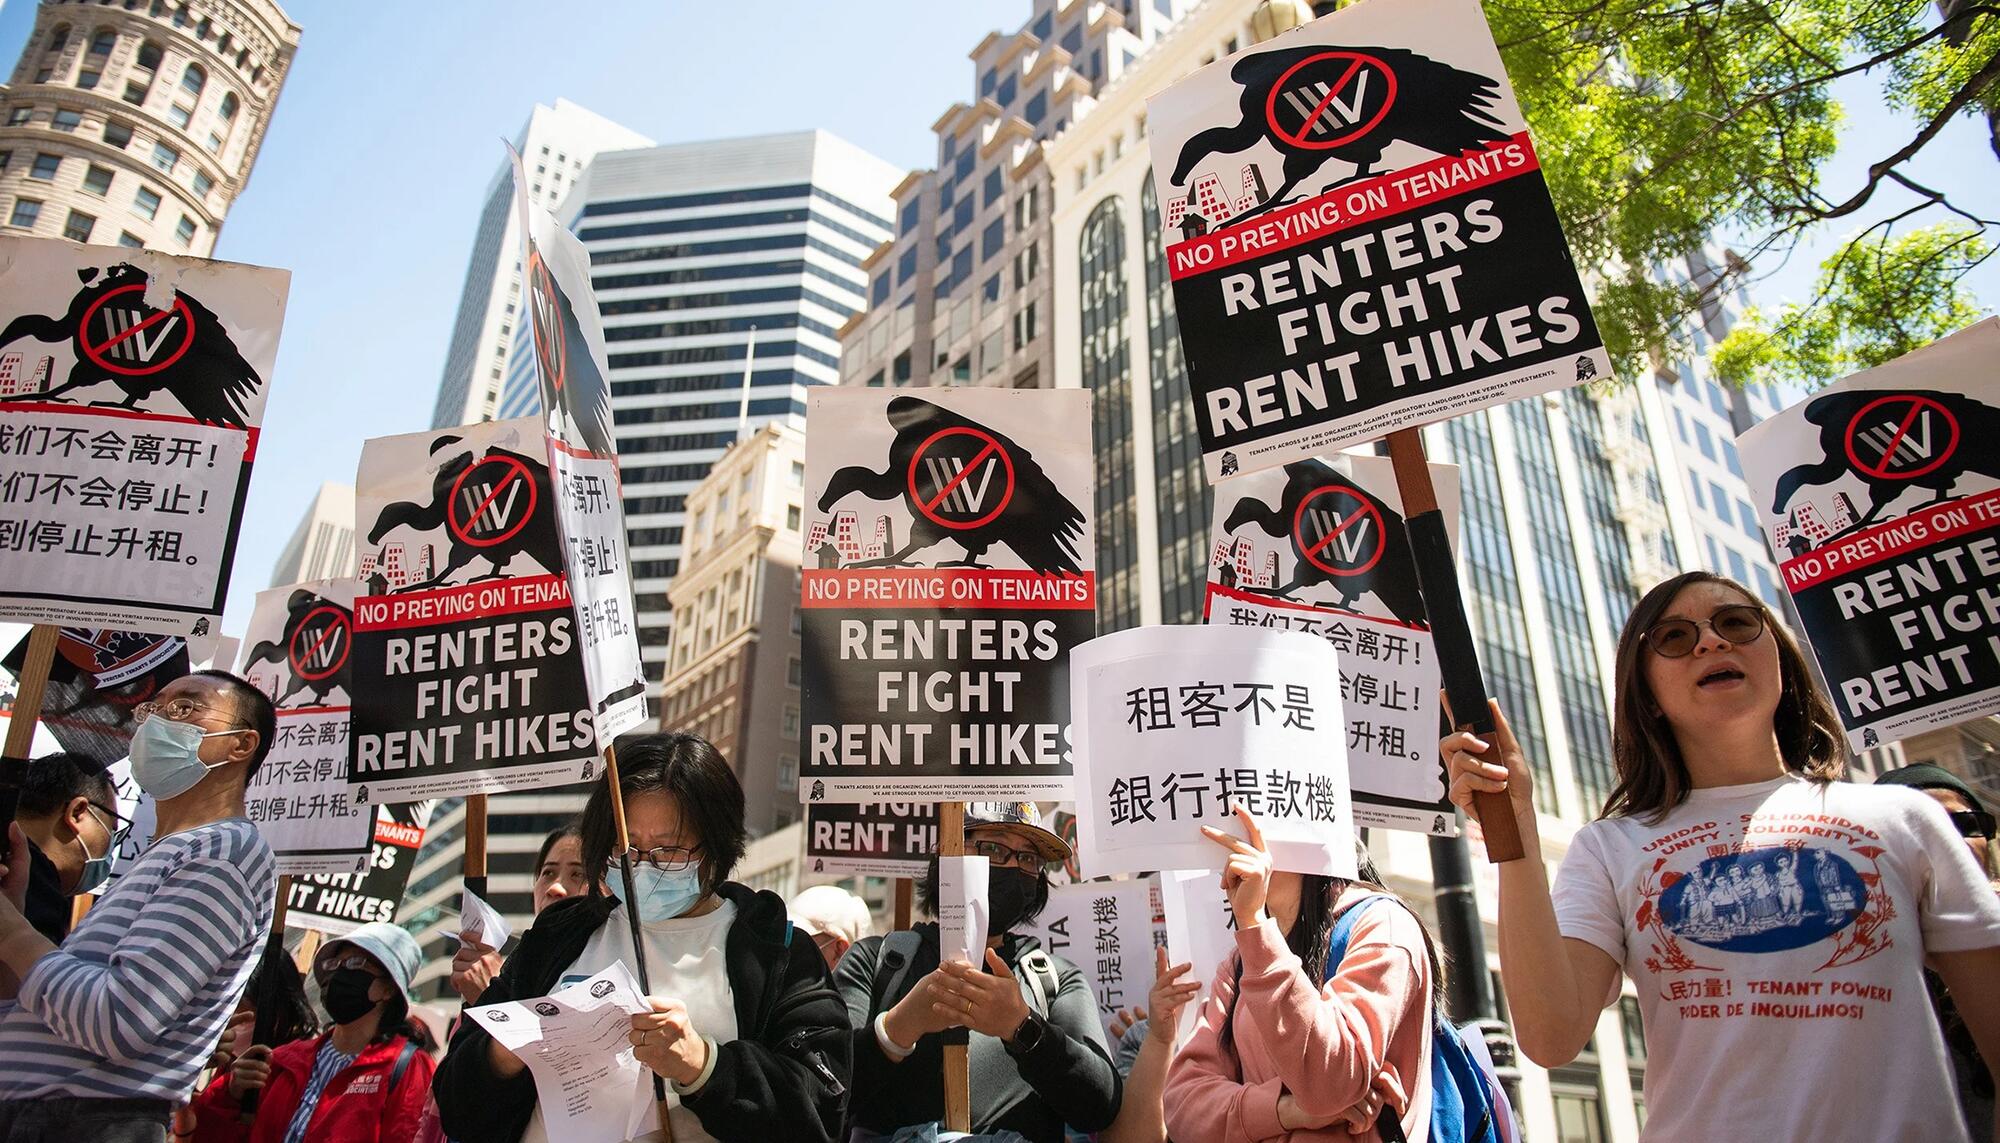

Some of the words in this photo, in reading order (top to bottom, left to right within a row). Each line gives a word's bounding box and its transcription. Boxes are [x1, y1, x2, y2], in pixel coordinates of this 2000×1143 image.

[1175, 244, 1214, 273] NO
[1221, 203, 1340, 258] PREYING
[1346, 185, 1388, 218] ON
[1392, 144, 1527, 203] TENANTS
[1220, 199, 1504, 317] RENTERS
[1277, 265, 1463, 355] FIGHT
[1206, 352, 1360, 438] RENT
[1383, 296, 1581, 388] HIKES
[1249, 445, 1276, 456] TENANTS
[1277, 438, 1300, 448] ACROSS
[1323, 422, 1361, 436] ORGANIZING
[1362, 413, 1388, 424] AGAINST
[1390, 403, 1426, 416] PREDATORY
[1427, 393, 1465, 406] LANDLORDS
[1481, 382, 1508, 392] VERITAS
[1324, 430, 1357, 443] STRONGER
[1451, 400, 1467, 408] VISIT
[0, 470, 208, 515] 们不会停止！
[1788, 558, 1822, 586] NO
[1829, 519, 1922, 572] PREYING
[1931, 508, 1969, 537] ON
[360, 599, 388, 623] NO
[393, 589, 475, 621] PREYING
[481, 588, 506, 610] ON
[511, 580, 572, 606] TENAN
[808, 578, 840, 600] NO
[847, 577, 944, 600] PREYING
[951, 577, 982, 600] ON
[988, 578, 1088, 601] TENANTS
[385, 616, 572, 675] RENTERS
[840, 619, 1059, 661] RENTERS
[416, 668, 538, 719] FIGHT
[877, 670, 1021, 712] FIGHT
[1840, 644, 1974, 719] RENT
[1126, 680, 1316, 733] 租客不是
[357, 724, 461, 773] RENT
[475, 709, 595, 760] HIKES
[811, 724, 932, 765] RENT
[244, 793, 358, 822] 到停止升租。
[1108, 767, 1336, 827] 銀行提款機
[814, 821, 895, 851] RENT
[1642, 821, 1717, 853] UNIDAD
[1740, 814, 1880, 841] SOLIDARIDAD
[1661, 831, 1720, 855] UNITY
[1742, 825, 1862, 846] SOLIDARITY
[316, 888, 396, 923] HIKES
[1727, 1003, 1743, 1017] DE
[1747, 981, 1823, 995] TENANT
